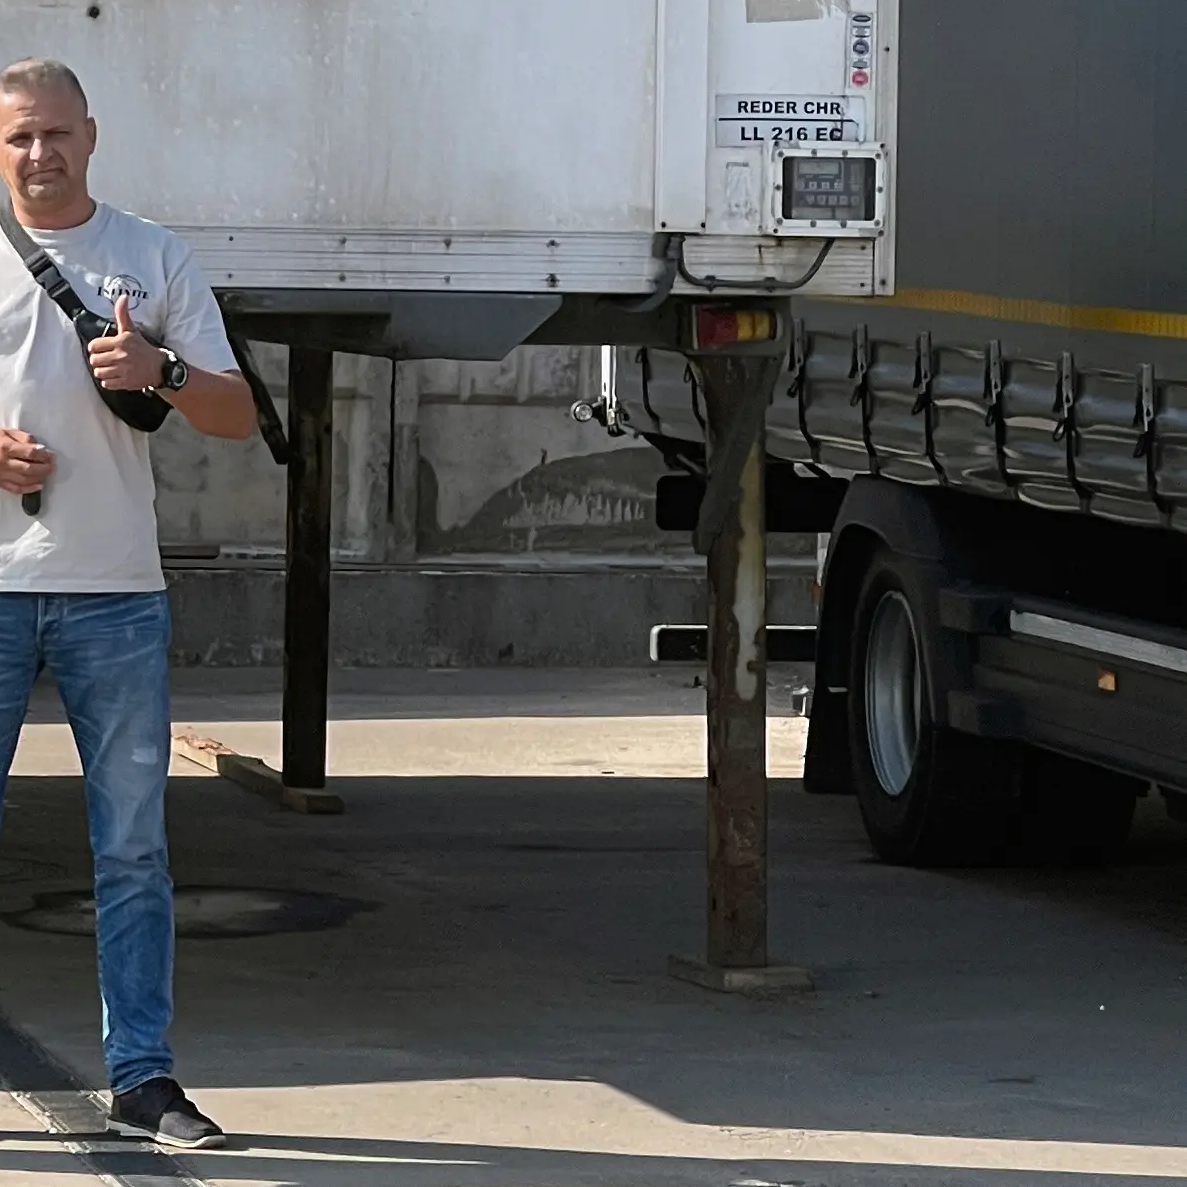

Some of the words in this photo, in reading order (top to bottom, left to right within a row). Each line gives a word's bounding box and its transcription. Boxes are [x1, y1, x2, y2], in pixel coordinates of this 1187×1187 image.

[737, 100, 798, 114] REDER
[803, 101, 841, 115] CHR
[740, 126, 765, 141] LL
[771, 126, 808, 141] 216
